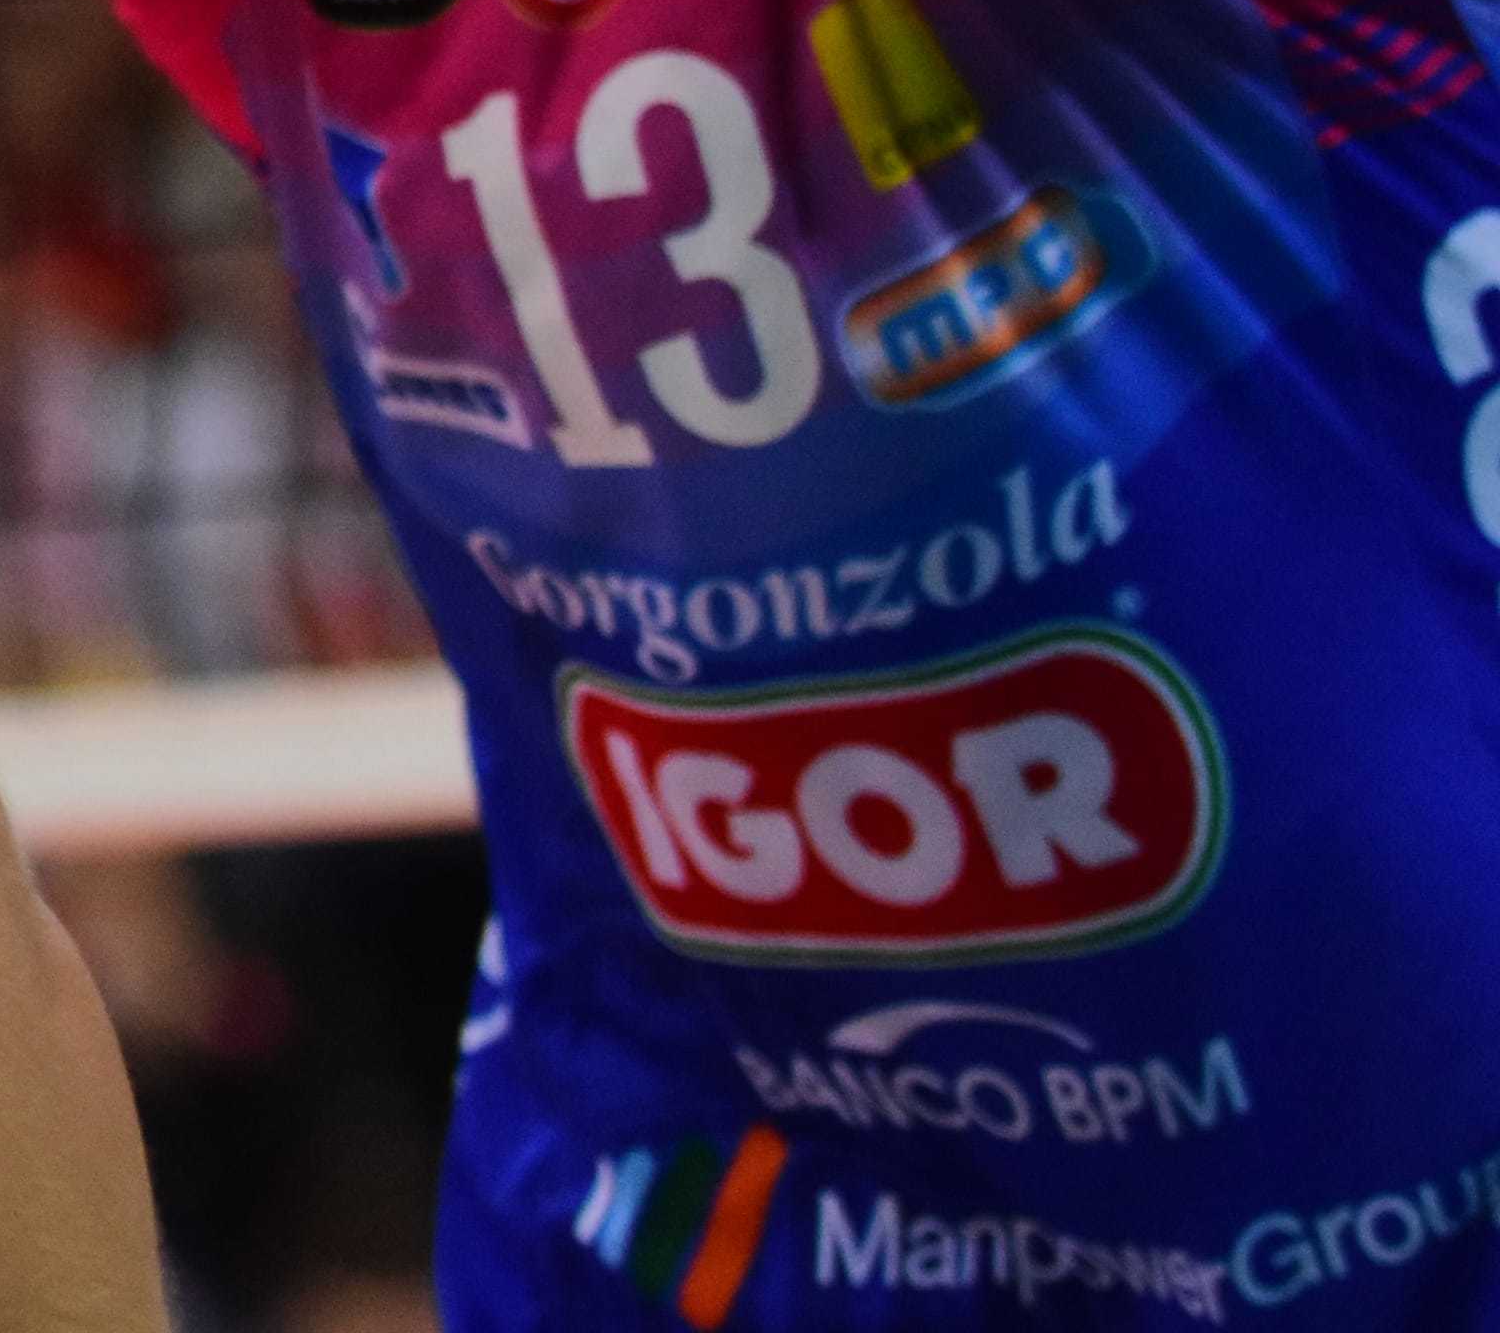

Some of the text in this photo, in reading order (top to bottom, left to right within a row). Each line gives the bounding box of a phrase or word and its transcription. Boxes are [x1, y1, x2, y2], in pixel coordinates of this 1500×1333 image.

[441, 49, 823, 469] 13
[606, 711, 1142, 907] IGOR
[1041, 1035, 1249, 1141] BPM
